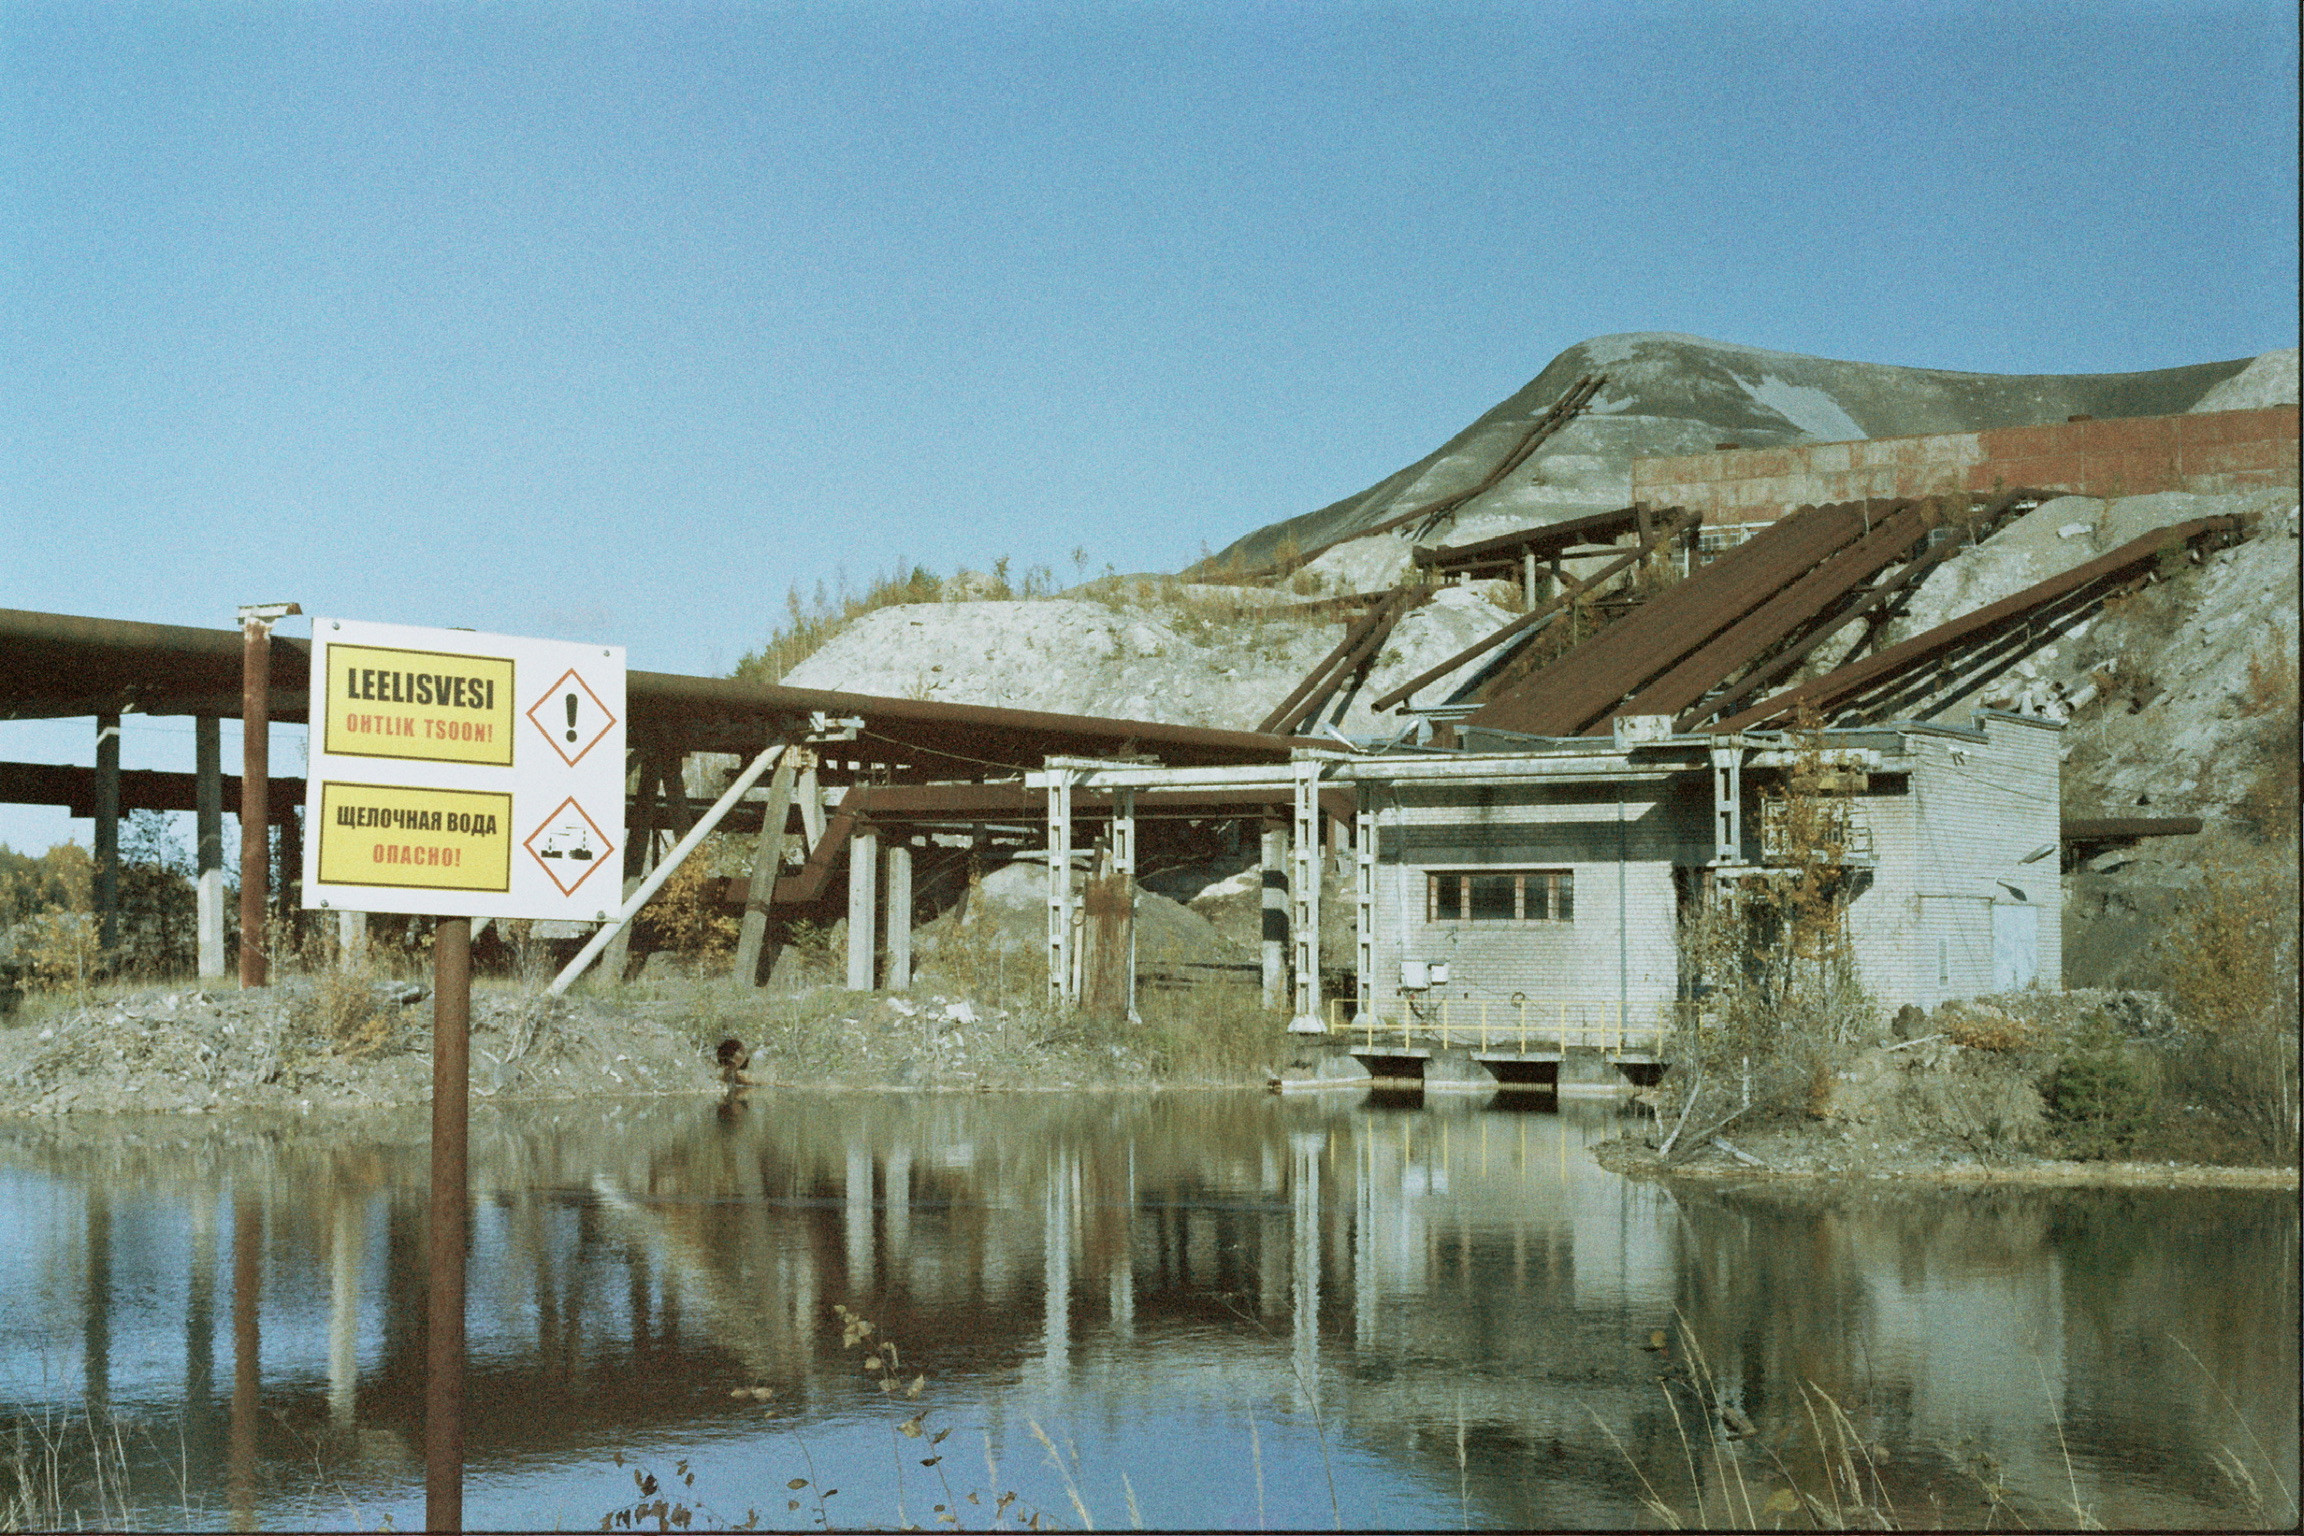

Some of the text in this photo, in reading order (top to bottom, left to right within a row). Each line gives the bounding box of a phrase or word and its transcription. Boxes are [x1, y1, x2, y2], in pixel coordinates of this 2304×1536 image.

[348, 667, 494, 710] LEELISVESI
[346, 713, 493, 743] OHTLIK TSOON!
[336, 805, 497, 837] ЩЕЛОЧНАЯ ВОДА
[372, 843, 461, 867] ОПАСНО!
